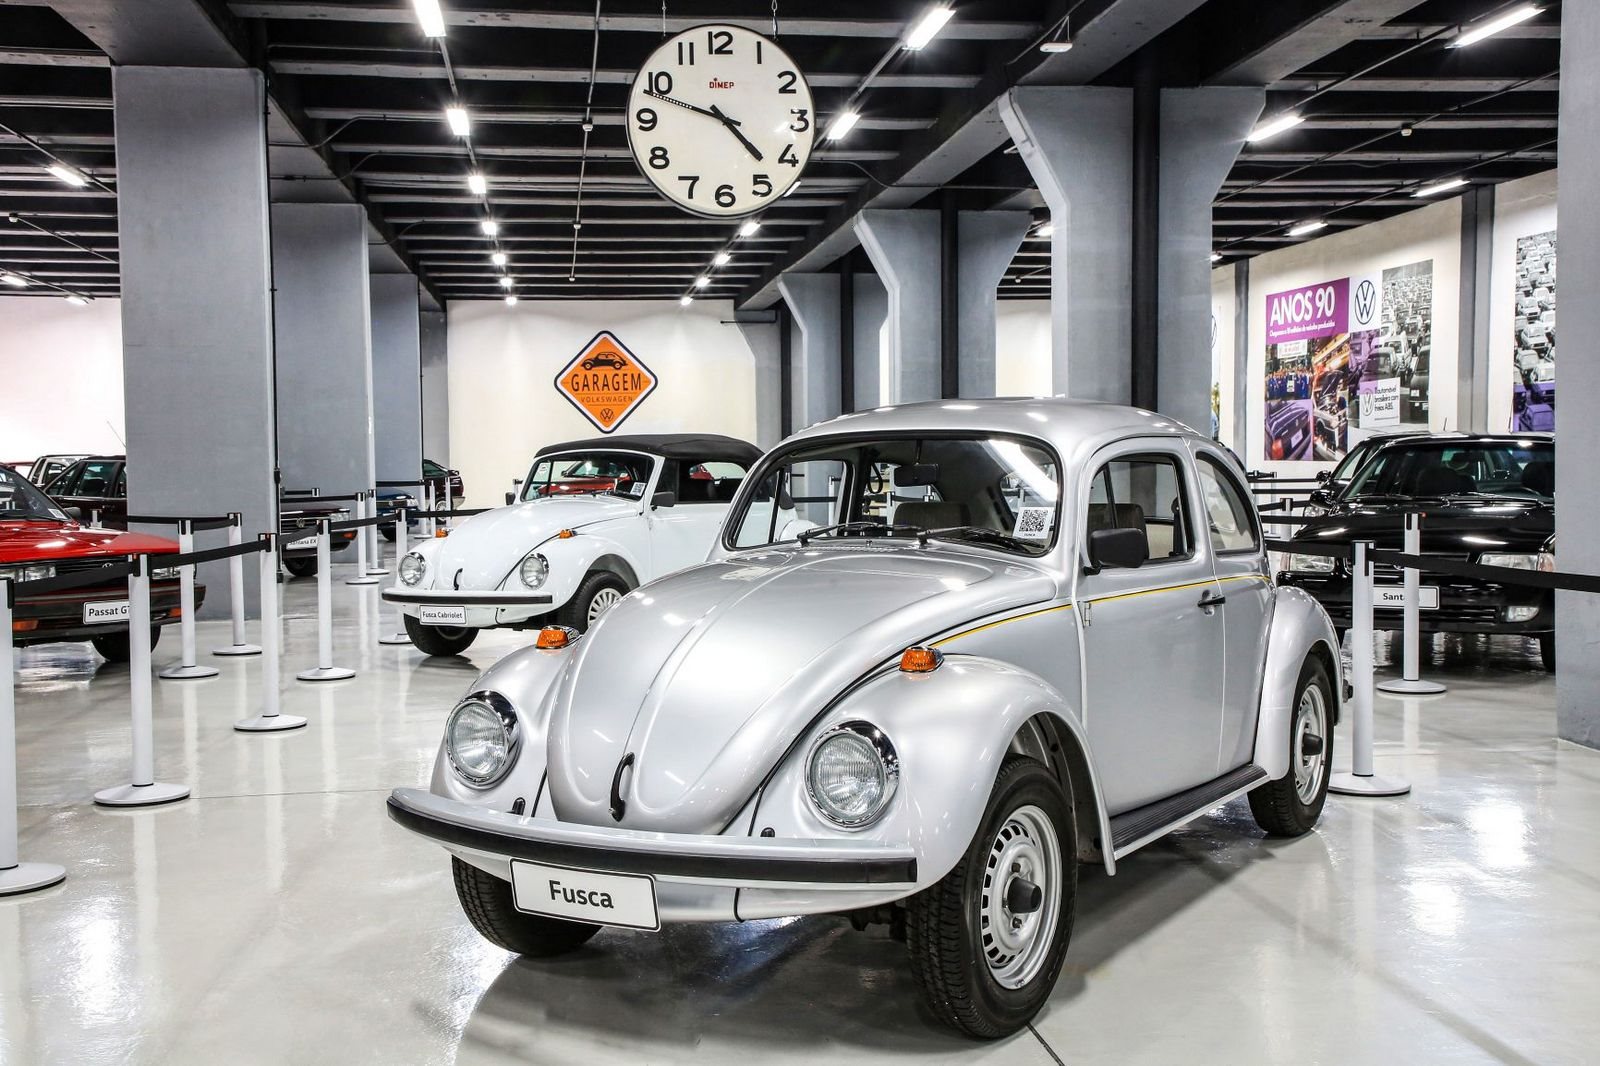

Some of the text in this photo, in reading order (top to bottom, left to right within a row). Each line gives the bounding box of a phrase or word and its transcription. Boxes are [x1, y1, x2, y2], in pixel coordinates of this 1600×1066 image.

[678, 41, 694, 65] 11
[708, 31, 733, 55] 12
[756, 41, 762, 65] 1
[647, 71, 673, 95] 10
[777, 71, 797, 94] 2
[636, 108, 658, 131] 9
[790, 109, 809, 132] 3
[649, 147, 670, 169] 8
[778, 144, 799, 168] 4
[678, 176, 699, 199] 7
[714, 184, 736, 208] 6
[752, 174, 772, 197] 5
[1269, 286, 1336, 327] ANOS 90
[571, 373, 642, 392] GARAGEM
[88, 608, 119, 617] Passat
[422, 611, 463, 619] Fusca Cabriolet
[549, 879, 615, 909] Fusca
